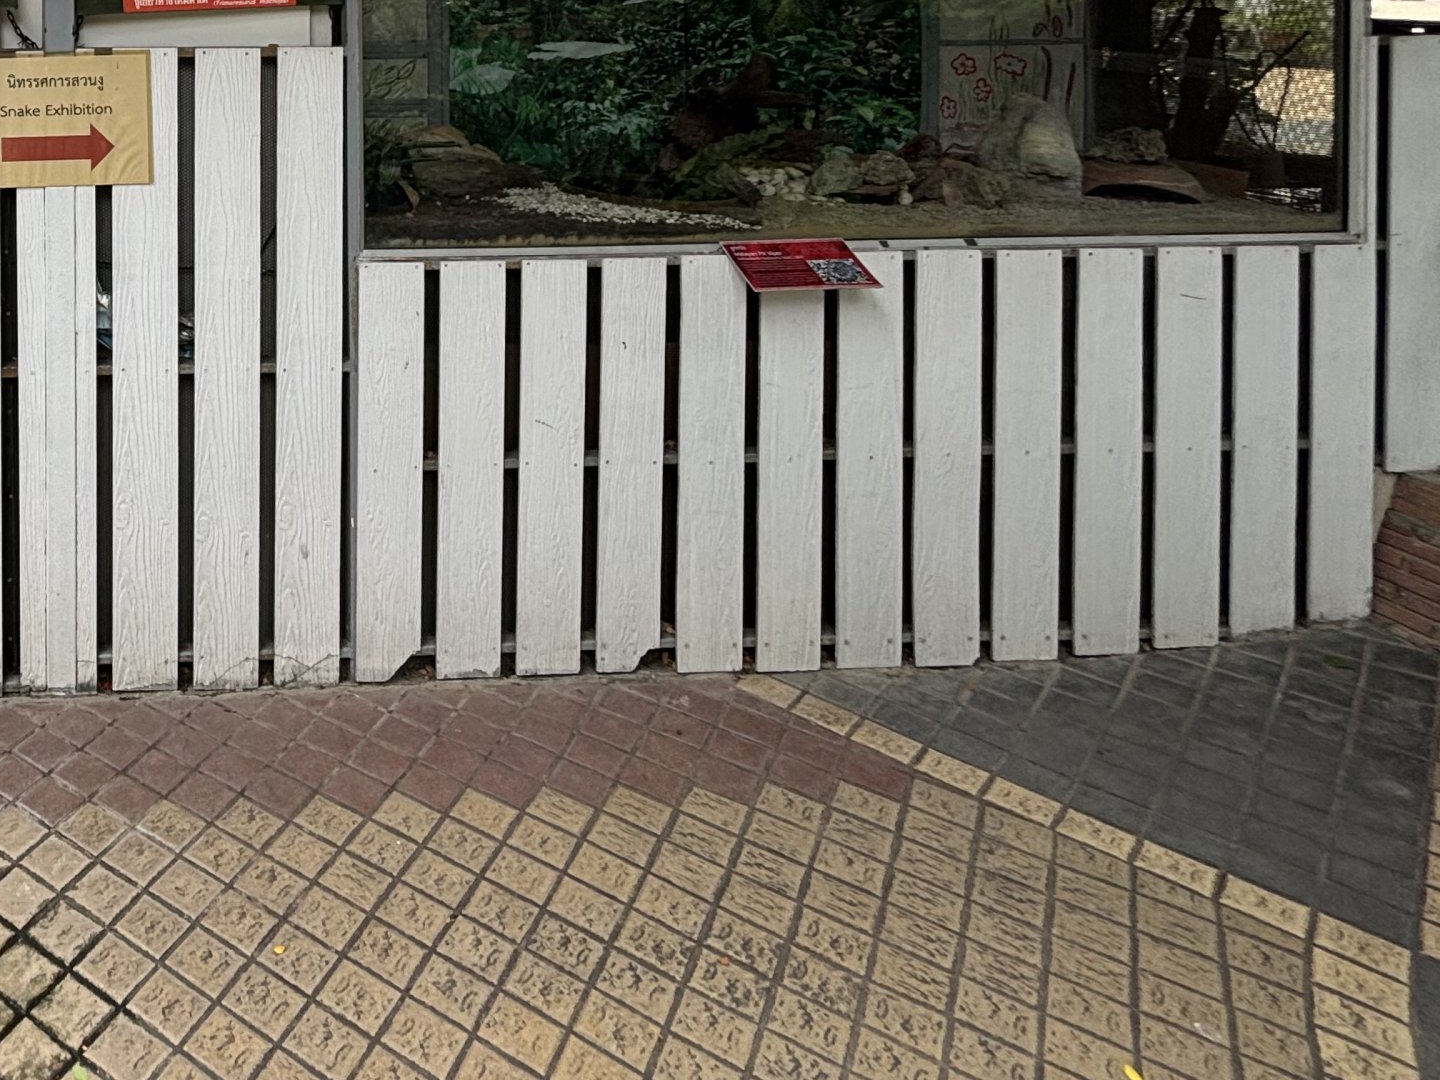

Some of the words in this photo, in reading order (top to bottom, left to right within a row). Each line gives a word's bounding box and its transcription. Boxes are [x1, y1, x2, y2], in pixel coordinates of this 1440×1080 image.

[6, 73, 105, 91] นิทรรศการสวนงู
[0, 104, 40, 118] Snake
[45, 102, 113, 116] Exhibition
